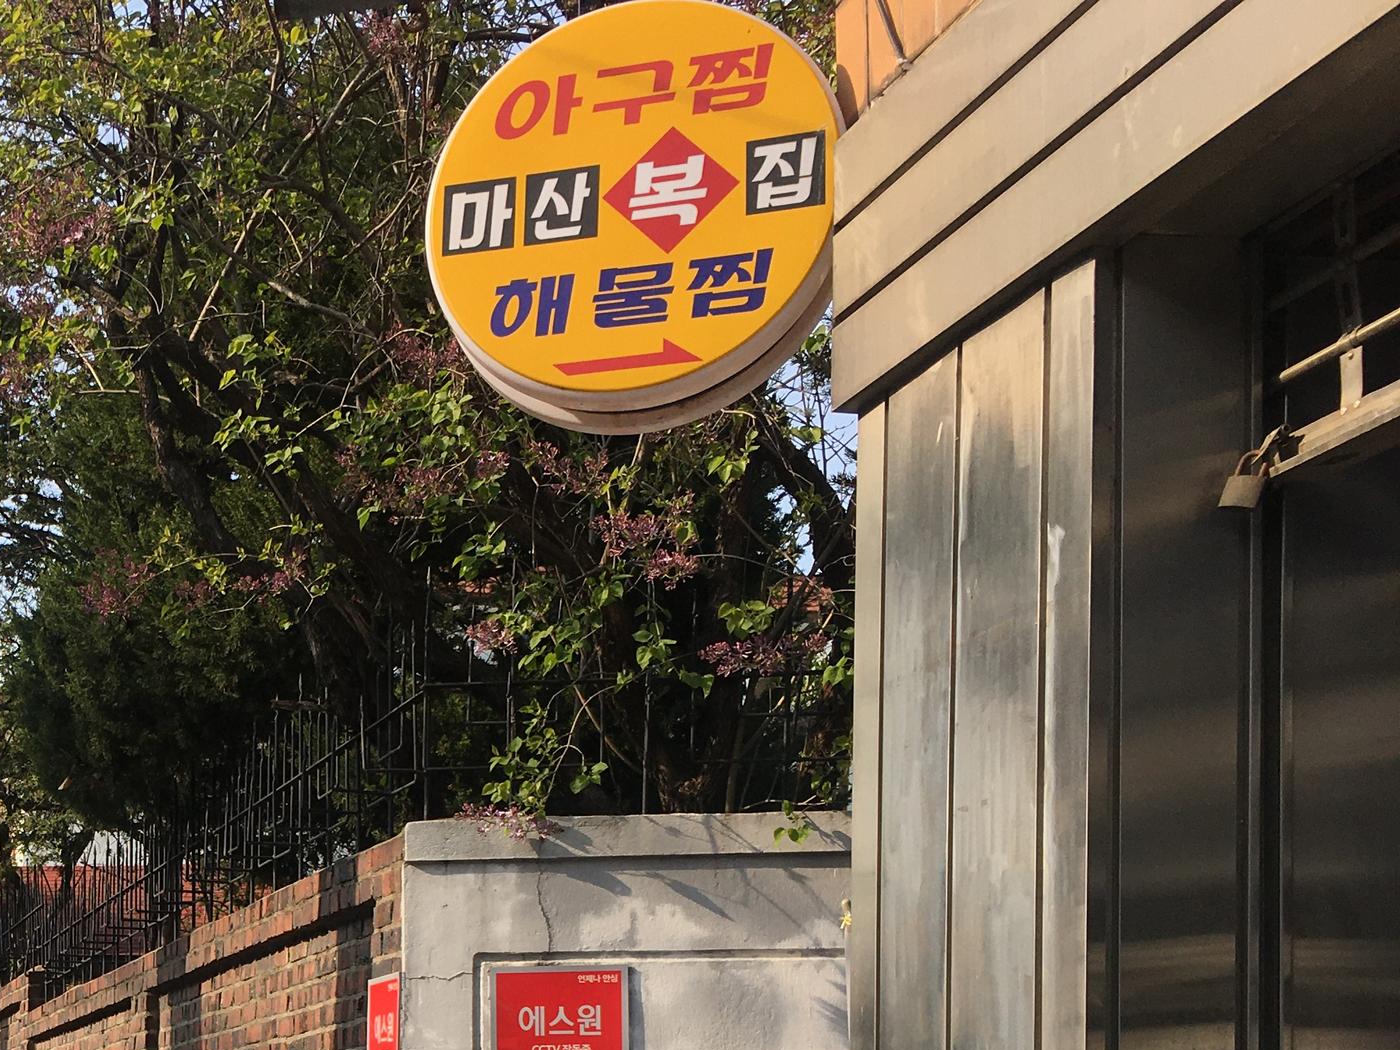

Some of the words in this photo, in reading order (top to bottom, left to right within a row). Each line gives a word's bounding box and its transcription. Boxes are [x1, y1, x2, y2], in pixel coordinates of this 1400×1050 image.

[494, 42, 774, 140] 아구찜
[490, 247, 774, 338] 해물찜
[578, 974, 601, 983] 언제나
[602, 974, 618, 983] 안심
[518, 1004, 602, 1036] 에스원
